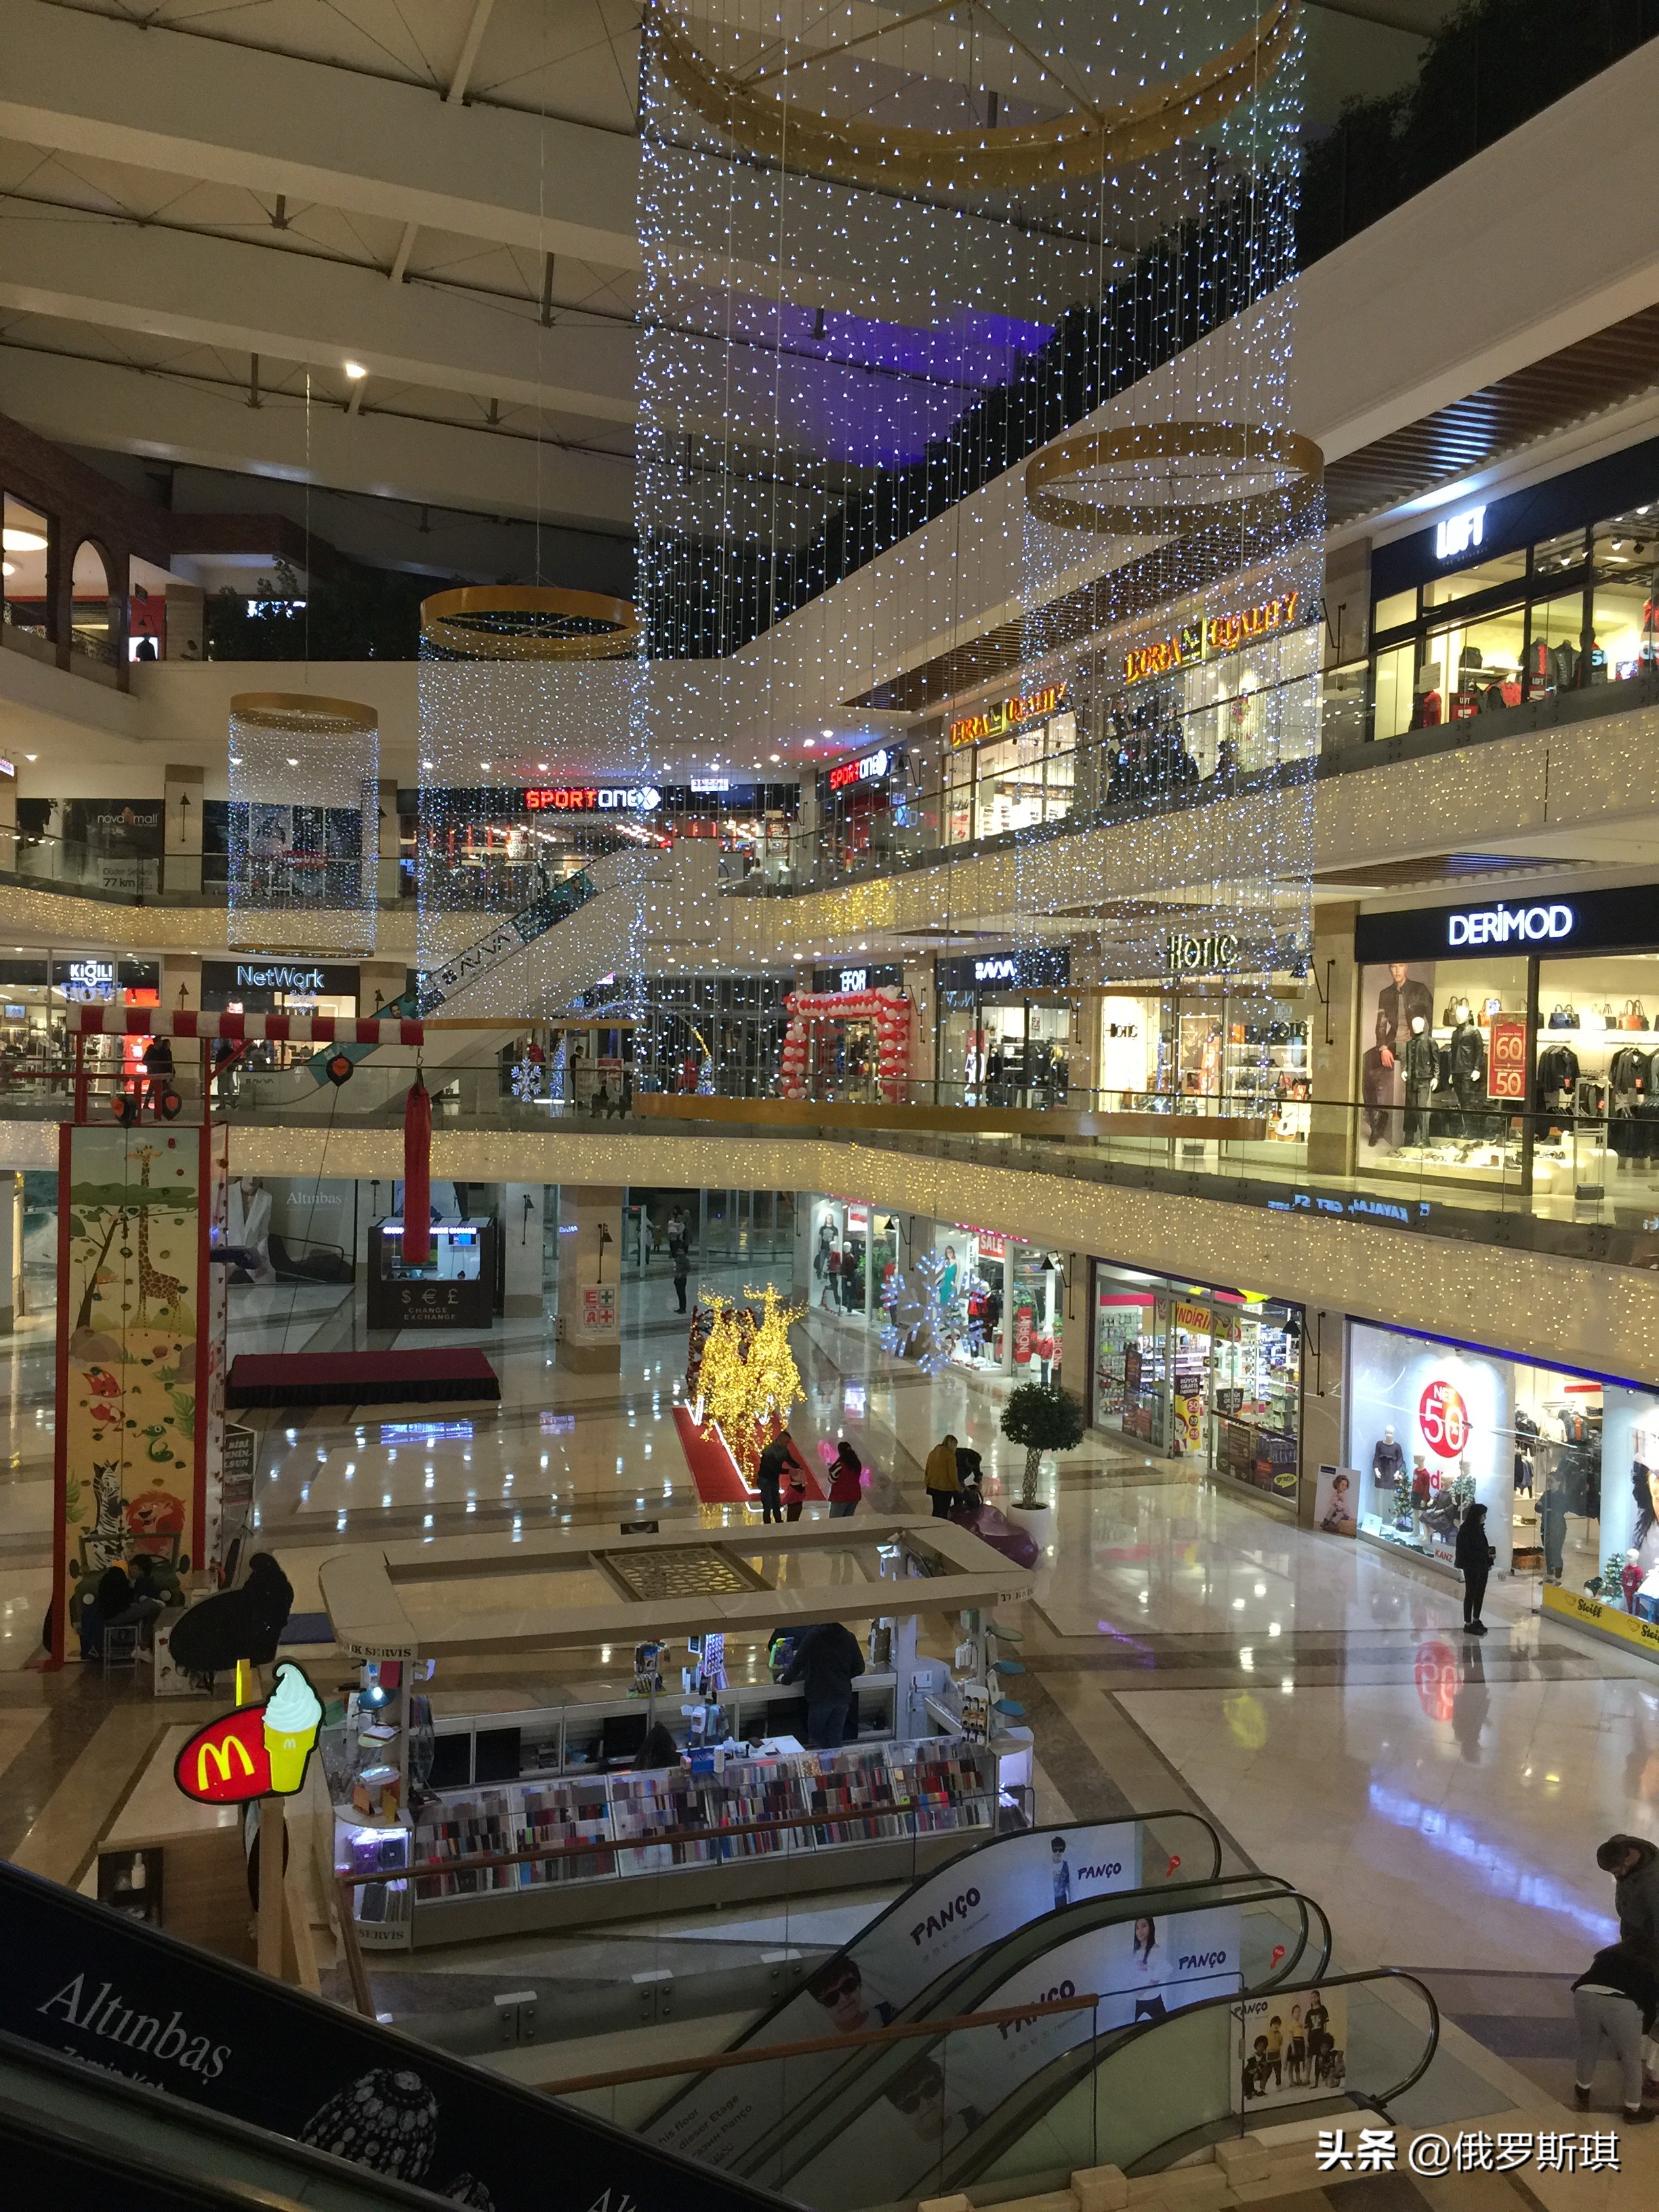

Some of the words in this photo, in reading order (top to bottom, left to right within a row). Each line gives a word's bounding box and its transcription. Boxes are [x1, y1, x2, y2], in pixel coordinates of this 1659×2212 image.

[1436, 506, 1486, 559] LOFT
[1207, 590, 1299, 650] QUALITY
[97, 815, 125, 823] nova
[133, 814, 158, 823] mall
[102, 878, 118, 887] 77
[119, 877, 136, 887] km
[1449, 904, 1573, 946] DERİMOD
[237, 964, 325, 989] NetWork
[1496, 1036, 1523, 1061] 60
[1495, 1072, 1521, 1096] 50
[981, 1233, 1004, 1254] SALE
[422, 1288, 438, 1305] €
[447, 1288, 459, 1305] £
[1187, 1400, 1199, 1410] 50
[1424, 1398, 1463, 1451] 50
[224, 1458, 250, 1469] LSUN
[1435, 1547, 1454, 1563] KANZ
[1577, 1598, 1603, 1618] Steiff
[1641, 1624, 1659, 1644] Stei
[1078, 1862, 1122, 1880] PANÇO
[909, 1887, 981, 1946] PANÇO
[1179, 1950, 1226, 1970] PANÇO
[37, 1973, 232, 2085] Altınbaş
[709, 2094, 739, 2123] Etage
